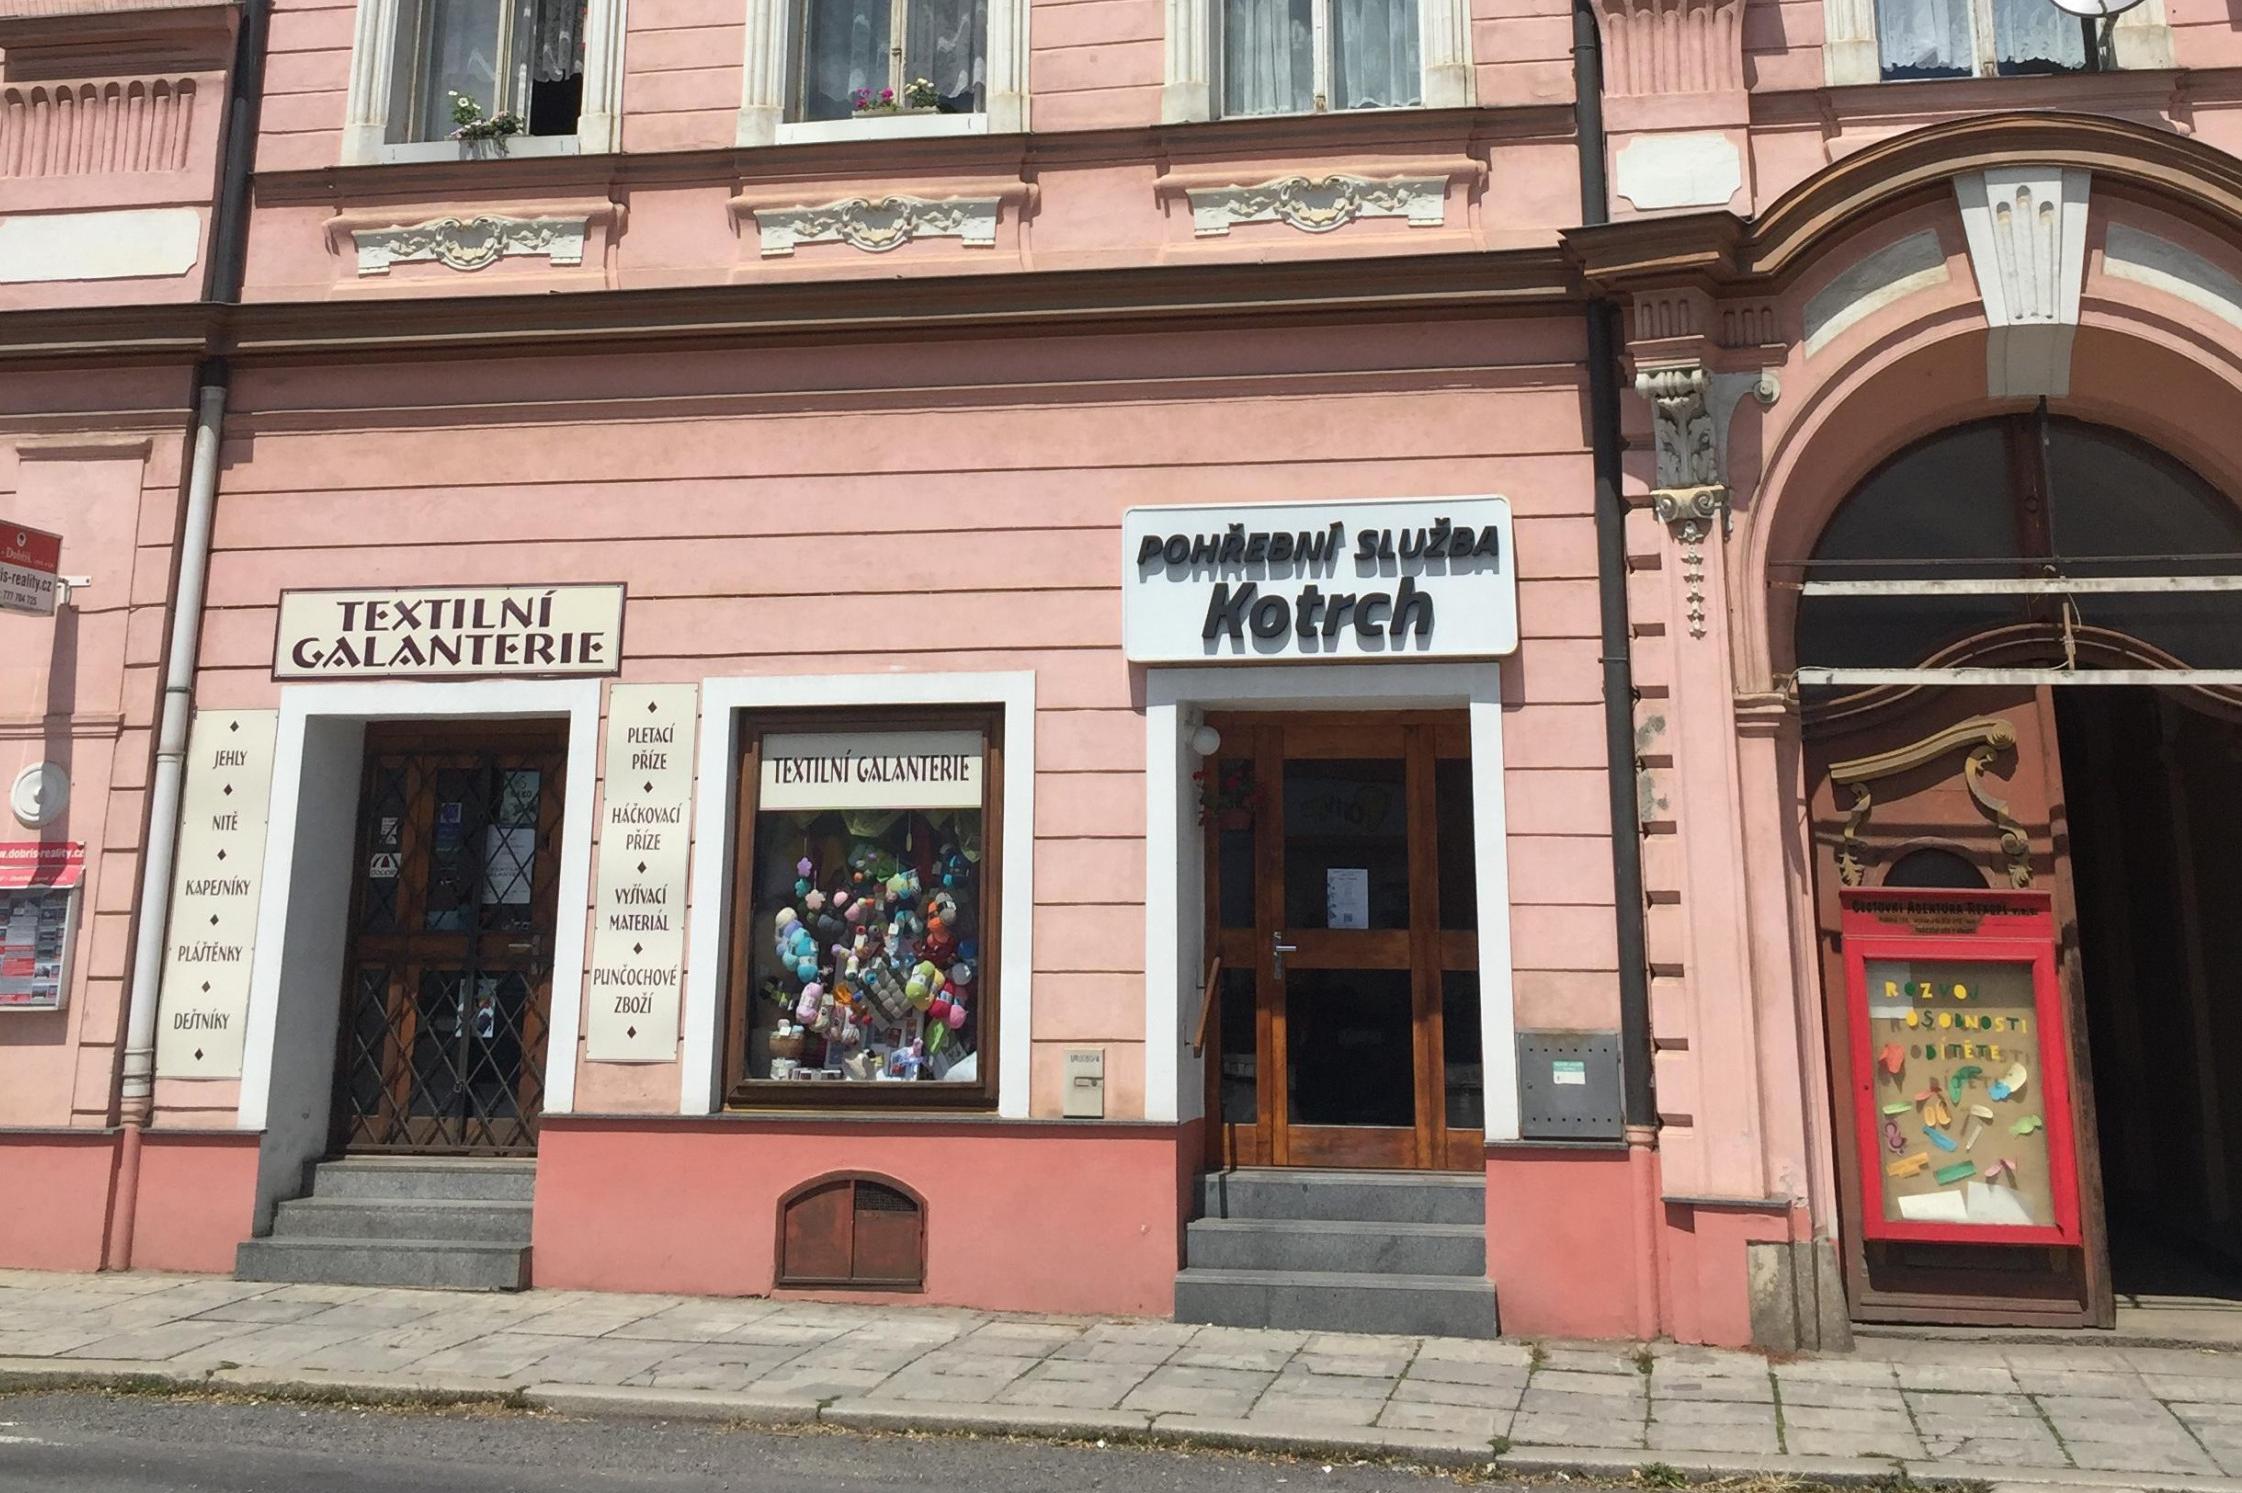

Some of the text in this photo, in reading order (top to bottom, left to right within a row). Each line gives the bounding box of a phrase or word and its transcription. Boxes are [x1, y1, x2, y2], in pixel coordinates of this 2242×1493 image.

[1137, 518, 1499, 566] POHŘEBNÍ SLUŽBA
[336, 590, 558, 632] TEXTILNÍ
[1202, 576, 1434, 642] Kotrch
[292, 632, 604, 668] GALANTERIE
[627, 723, 675, 743] PLETACÍ
[212, 750, 247, 769] JEHLY
[632, 749, 667, 770] PŘÍZE
[773, 749, 970, 783] TEXTILNÍ GALANTERIE
[212, 811, 238, 830] NITĚ
[612, 803, 683, 823] HÁČKOVACÍ
[626, 829, 661, 850] PŘÍZE
[185, 875, 250, 896] KAPESNÍKY
[615, 884, 668, 904] VYŠÍVACÍ
[610, 909, 669, 931] MATERIÁL
[178, 940, 242, 962] PLÁŠTĚNKY
[593, 963, 677, 986] PUNČOCHOVÉ
[1884, 981, 1979, 1000] ROZVOJ
[614, 992, 654, 1013] ZBOŽÍ
[174, 1008, 230, 1030] DEŠTNÍKY
